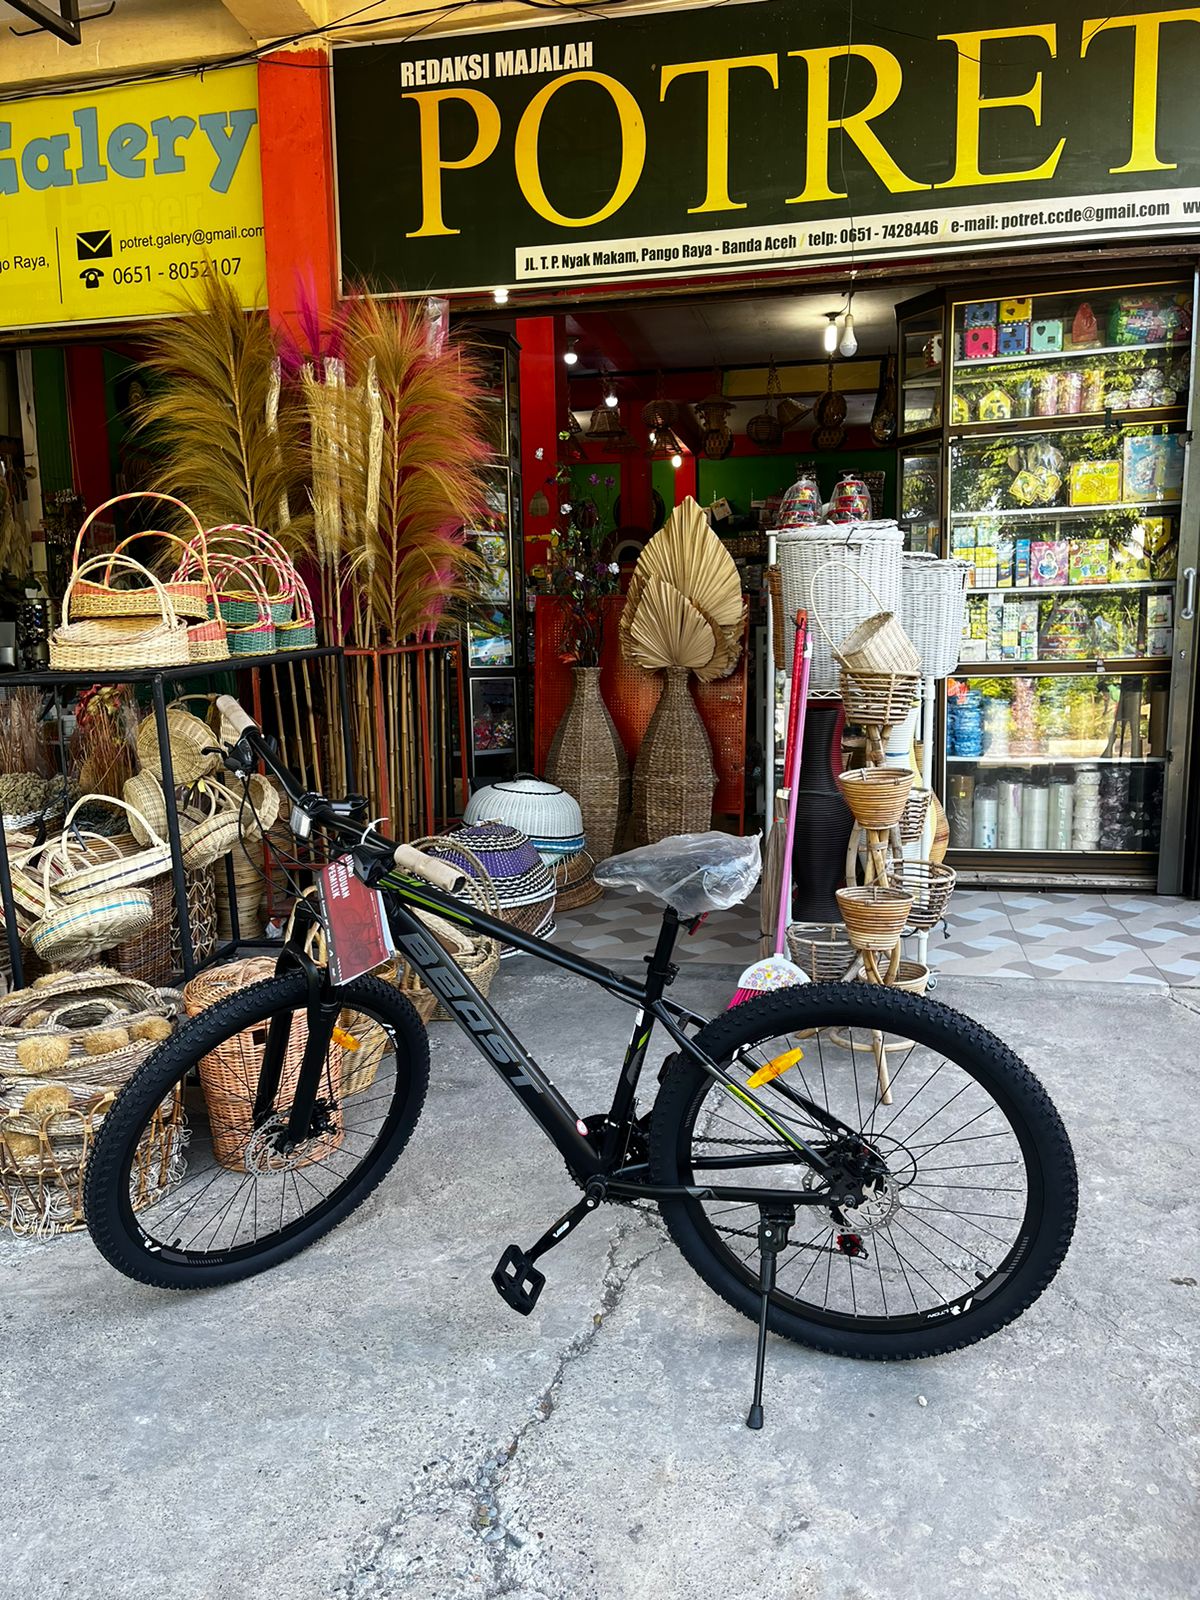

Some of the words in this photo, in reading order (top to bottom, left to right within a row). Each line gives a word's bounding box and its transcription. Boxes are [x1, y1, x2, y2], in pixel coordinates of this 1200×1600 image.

[401, 53, 490, 87] REDAKSI
[495, 41, 593, 77] MAJALAH
[401, 8, 1200, 239] POTRET
[119, 226, 264, 252] potret.galery@gmail.com
[525, 257, 539, 271] JL.
[540, 256, 549, 270] T.
[551, 255, 560, 269] P.
[562, 252, 591, 269] Nyak
[593, 250, 639, 266] Makam,
[641, 246, 679, 263] Pango
[682, 243, 712, 258] Raya
[722, 237, 762, 255] Banda
[764, 234, 797, 251] Aceh
[808, 231, 837, 247] telp:
[840, 226, 871, 243] 0651
[882, 220, 939, 239] 7428446
[951, 215, 998, 233] e-mail:
[1001, 202, 1170, 230] potret.ccde@gmail.com
[13, 255, 50, 271] Raya,
[113, 265, 151, 285] 0651
[168, 257, 242, 280] 8052107
[327, 864, 341, 900] PEMILIK
[399, 932, 544, 1095] BEAST
